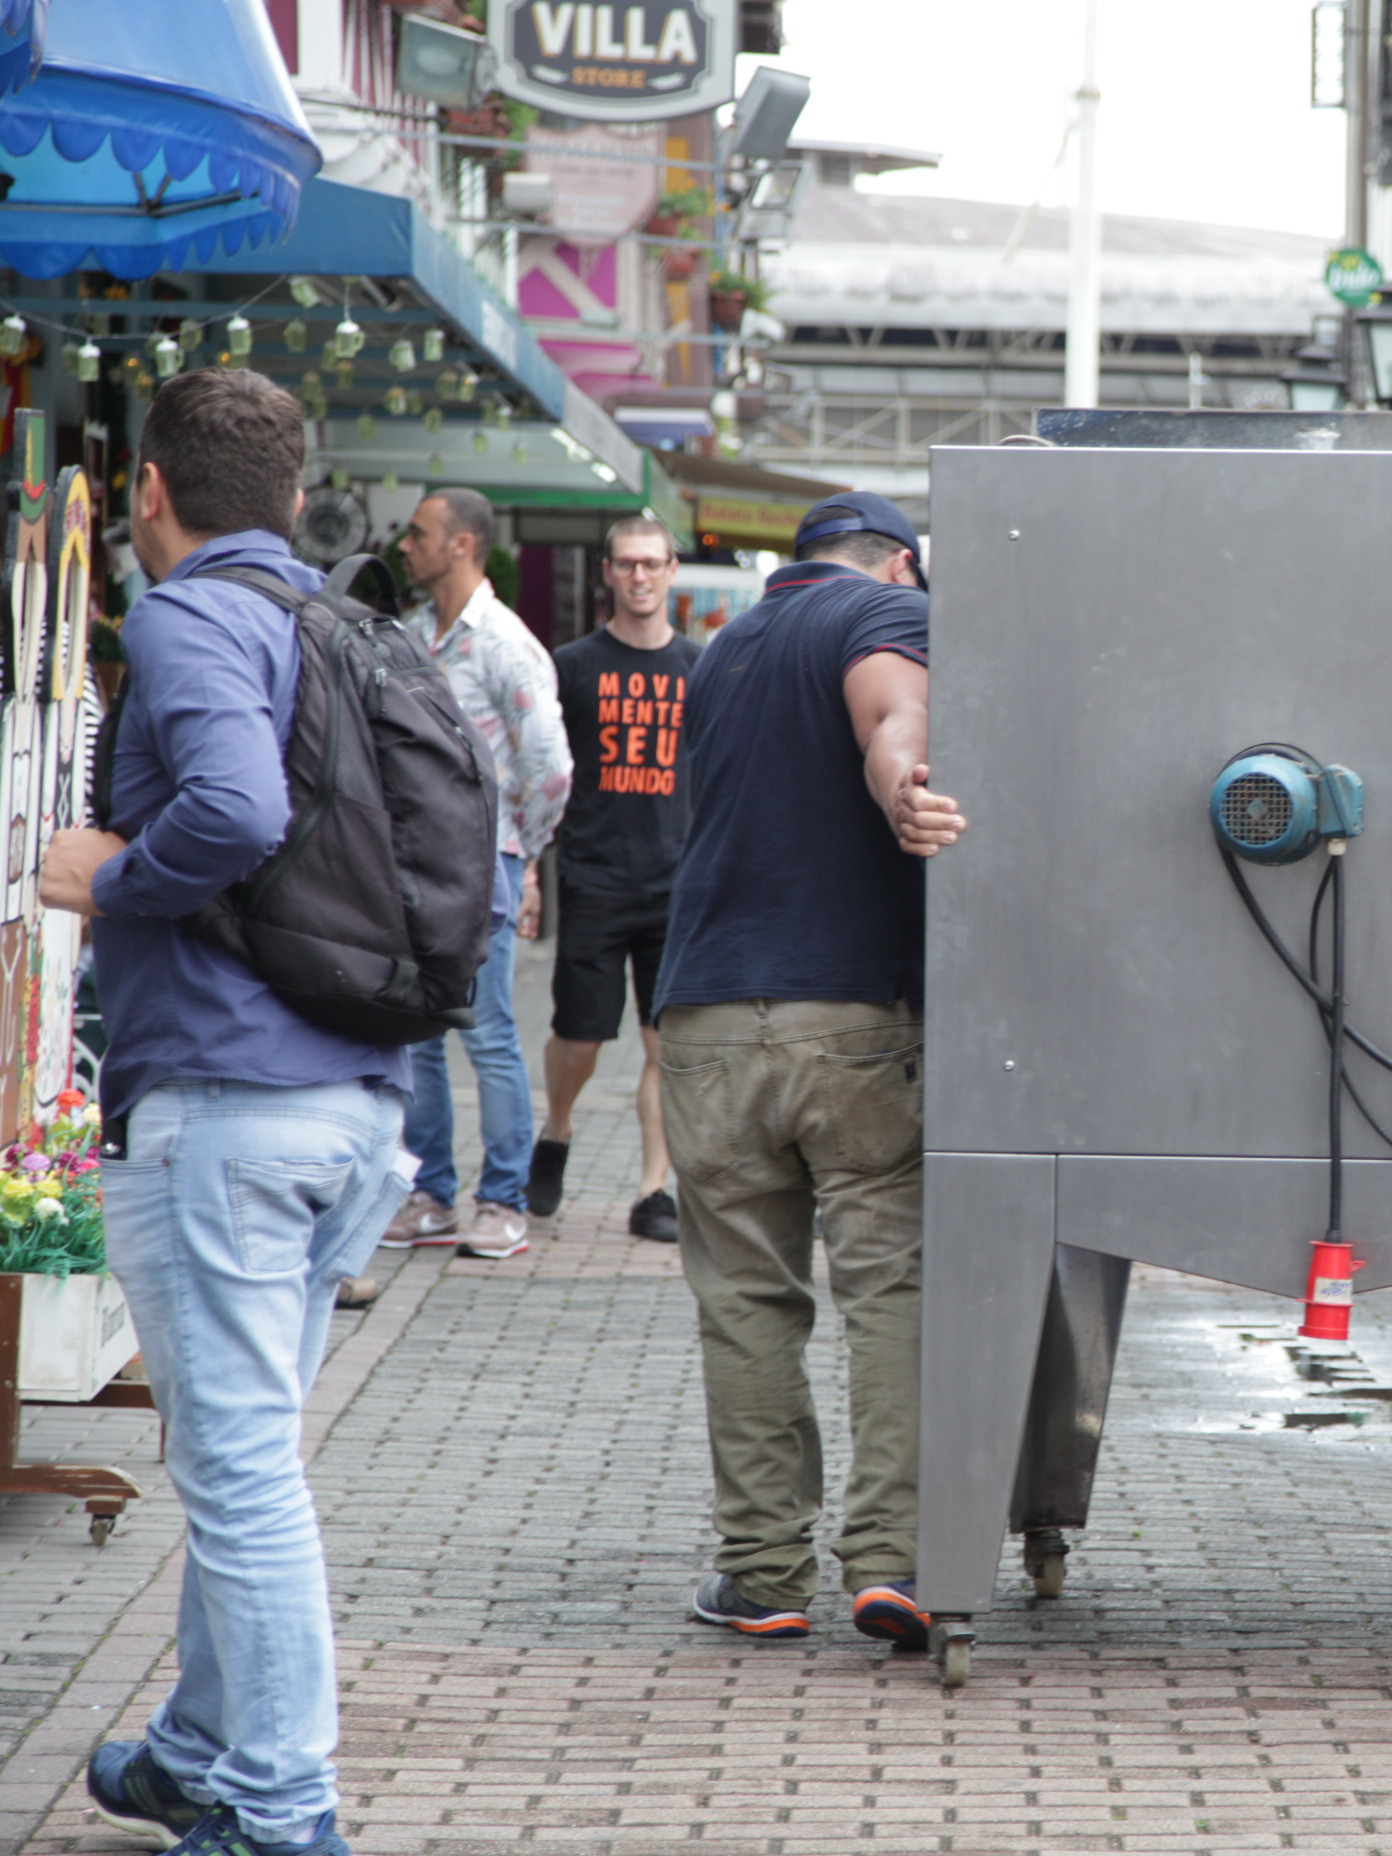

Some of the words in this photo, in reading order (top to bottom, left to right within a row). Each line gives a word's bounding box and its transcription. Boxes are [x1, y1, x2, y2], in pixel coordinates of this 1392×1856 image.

[531, 2, 698, 66] VILLA
[571, 67, 647, 89] STORE
[598, 672, 685, 700] MOVI
[598, 698, 684, 727] MENTE
[599, 725, 679, 767] SEU
[599, 766, 676, 796] MUNDO
